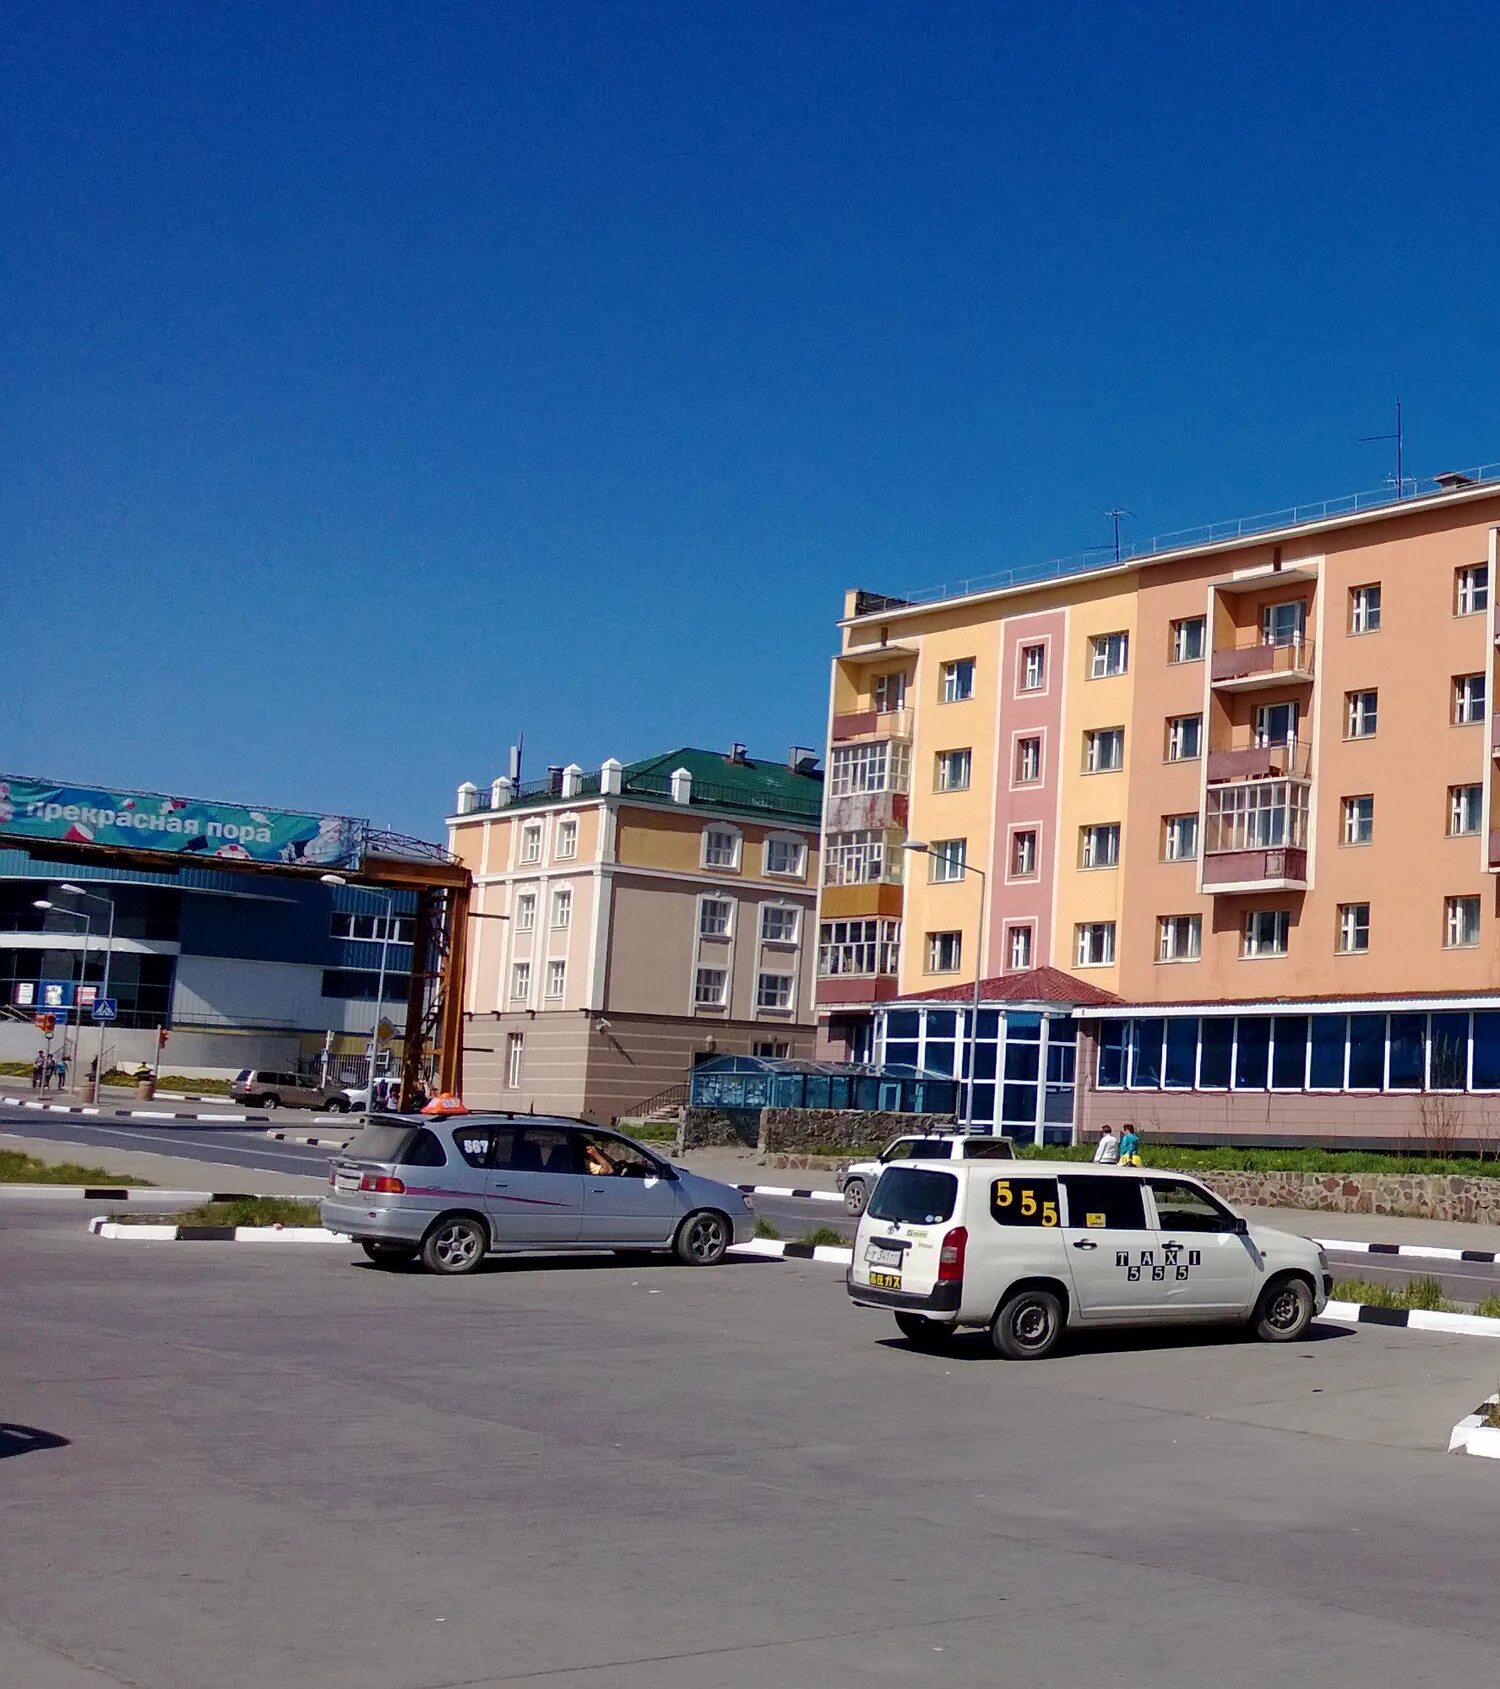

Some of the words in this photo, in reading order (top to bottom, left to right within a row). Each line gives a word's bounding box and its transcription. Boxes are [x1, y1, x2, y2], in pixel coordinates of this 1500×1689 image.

[207, 822, 272, 844] пора
[464, 1140, 488, 1153] 567
[1118, 1252, 1197, 1266] TAXI
[1129, 1267, 1187, 1280] 555
